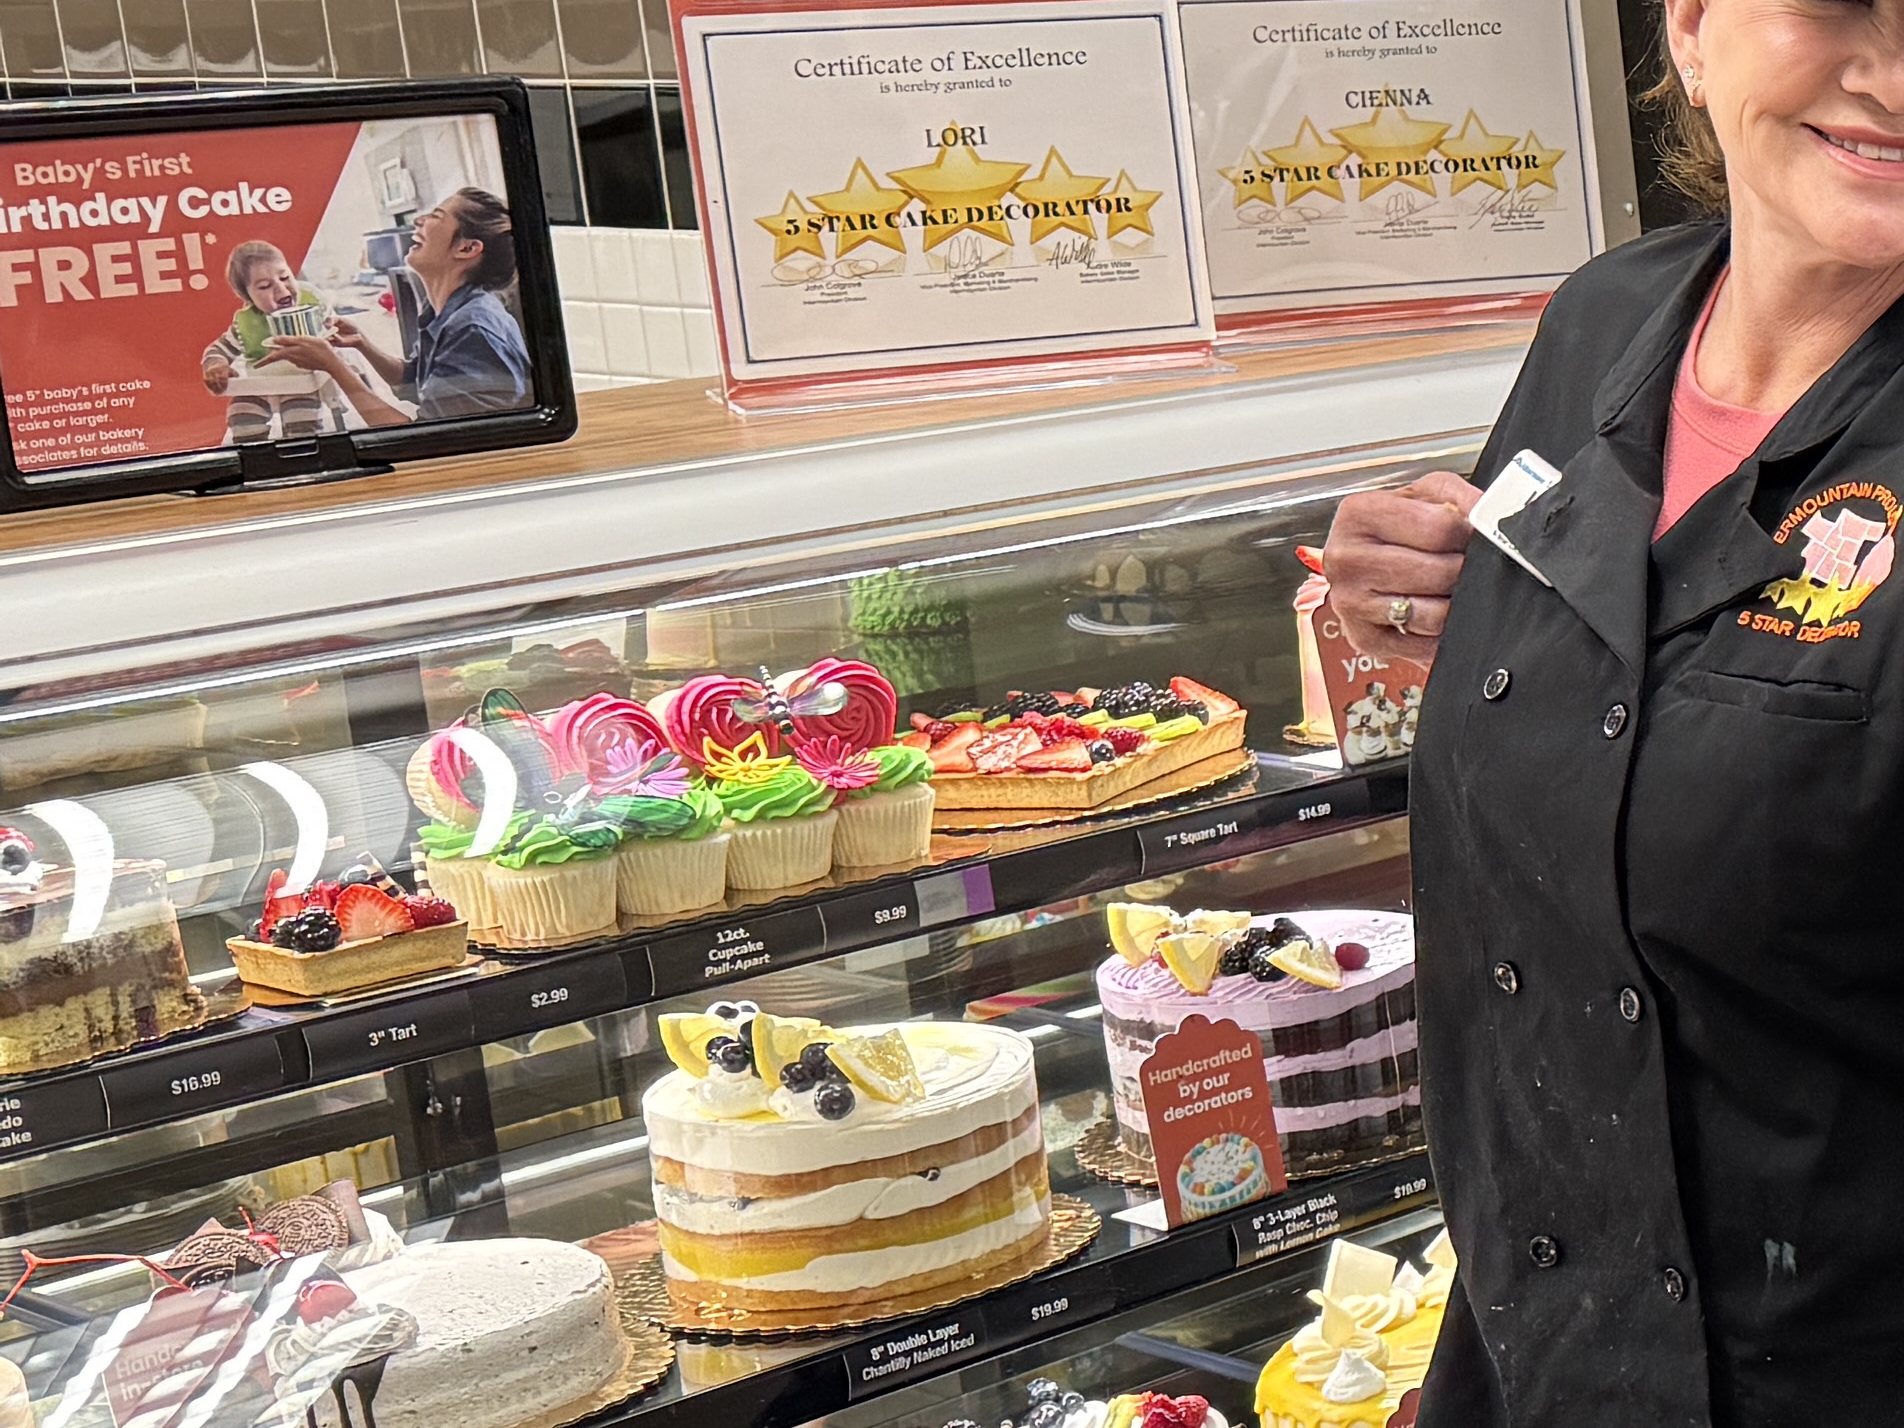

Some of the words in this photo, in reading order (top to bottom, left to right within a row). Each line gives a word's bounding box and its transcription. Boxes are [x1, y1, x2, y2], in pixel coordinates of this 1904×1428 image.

[1252, 22, 1363, 44] Certificate
[1368, 20, 1389, 41] of
[1395, 17, 1503, 39] Excellence
[794, 54, 923, 79] Certificate
[930, 51, 956, 73] of
[963, 47, 1088, 71] Excellence
[1337, 47, 1377, 61] hereby
[1379, 45, 1425, 60] granted
[1426, 44, 1438, 56] to
[879, 81, 892, 94] is
[894, 79, 940, 94] hereby
[943, 77, 996, 94] granted
[998, 76, 1013, 89] to
[1344, 88, 1434, 110] CIENNA
[925, 125, 989, 148] LORI
[14, 158, 122, 189] Baby's
[126, 152, 193, 178] First
[1241, 169, 1256, 186] 5
[1260, 164, 1322, 184] STAR
[1327, 160, 1390, 181] CAKE
[1395, 153, 1541, 177] DECORATOR
[0, 192, 168, 233] irthday
[178, 181, 293, 219] Cake
[784, 218, 802, 237] 5
[806, 211, 880, 235] STAR
[884, 206, 960, 230] CAKE
[964, 195, 1134, 225] DECORATOR
[44, 385, 89, 399] baby's
[91, 382, 117, 395] first
[119, 379, 151, 392] cake
[29, 401, 92, 418] purchase
[95, 397, 108, 409] of
[110, 397, 136, 409] any
[17, 418, 50, 432] cake
[53, 417, 67, 428] or
[30, 436, 56, 448] one
[58, 433, 71, 446] of
[74, 432, 97, 444] our
[99, 427, 145, 441] bakery
[80, 445, 99, 458] for
[1737, 610, 1752, 626] 5
[1751, 613, 1795, 637] STAR
[1180, 827, 1217, 845] Square
[1218, 821, 1239, 837] Tart
[874, 905, 907, 925] $9.99
[716, 927, 750, 944] 12ct.
[708, 940, 765, 962] Cupcake
[704, 953, 771, 978] Pull-Apart
[390, 1023, 418, 1042] Tart
[531, 987, 569, 1008] $2.99
[1148, 1042, 1253, 1087] Handcrafted
[171, 1071, 221, 1096] $16.99
[1178, 1079, 1200, 1100] by
[1202, 1072, 1231, 1091] our
[1163, 1086, 1253, 1123] decorators
[1306, 1193, 1338, 1213] Black
[886, 1333, 929, 1357] Double
[928, 1323, 961, 1343] Layer
[1031, 1298, 1069, 1321] $19.99
[912, 1344, 950, 1365] Naked
[950, 1333, 976, 1353] Iced
